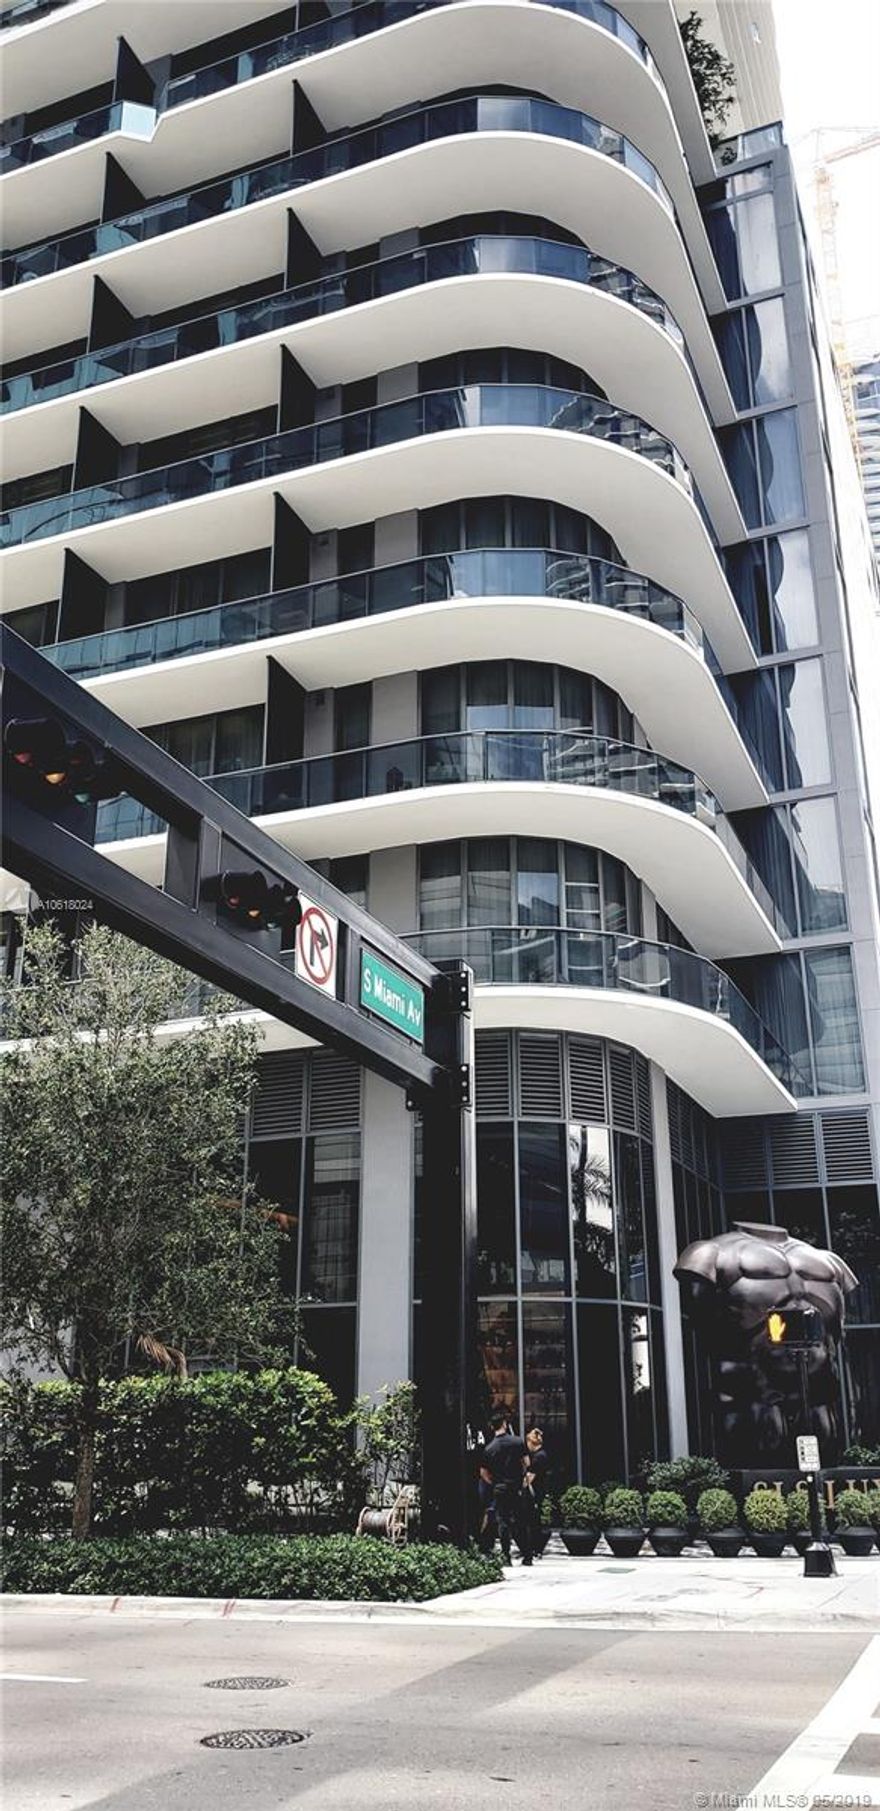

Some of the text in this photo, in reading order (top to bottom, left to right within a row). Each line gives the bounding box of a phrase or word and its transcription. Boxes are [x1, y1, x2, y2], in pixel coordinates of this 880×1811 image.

[363, 968, 421, 1027] S Miami Av
